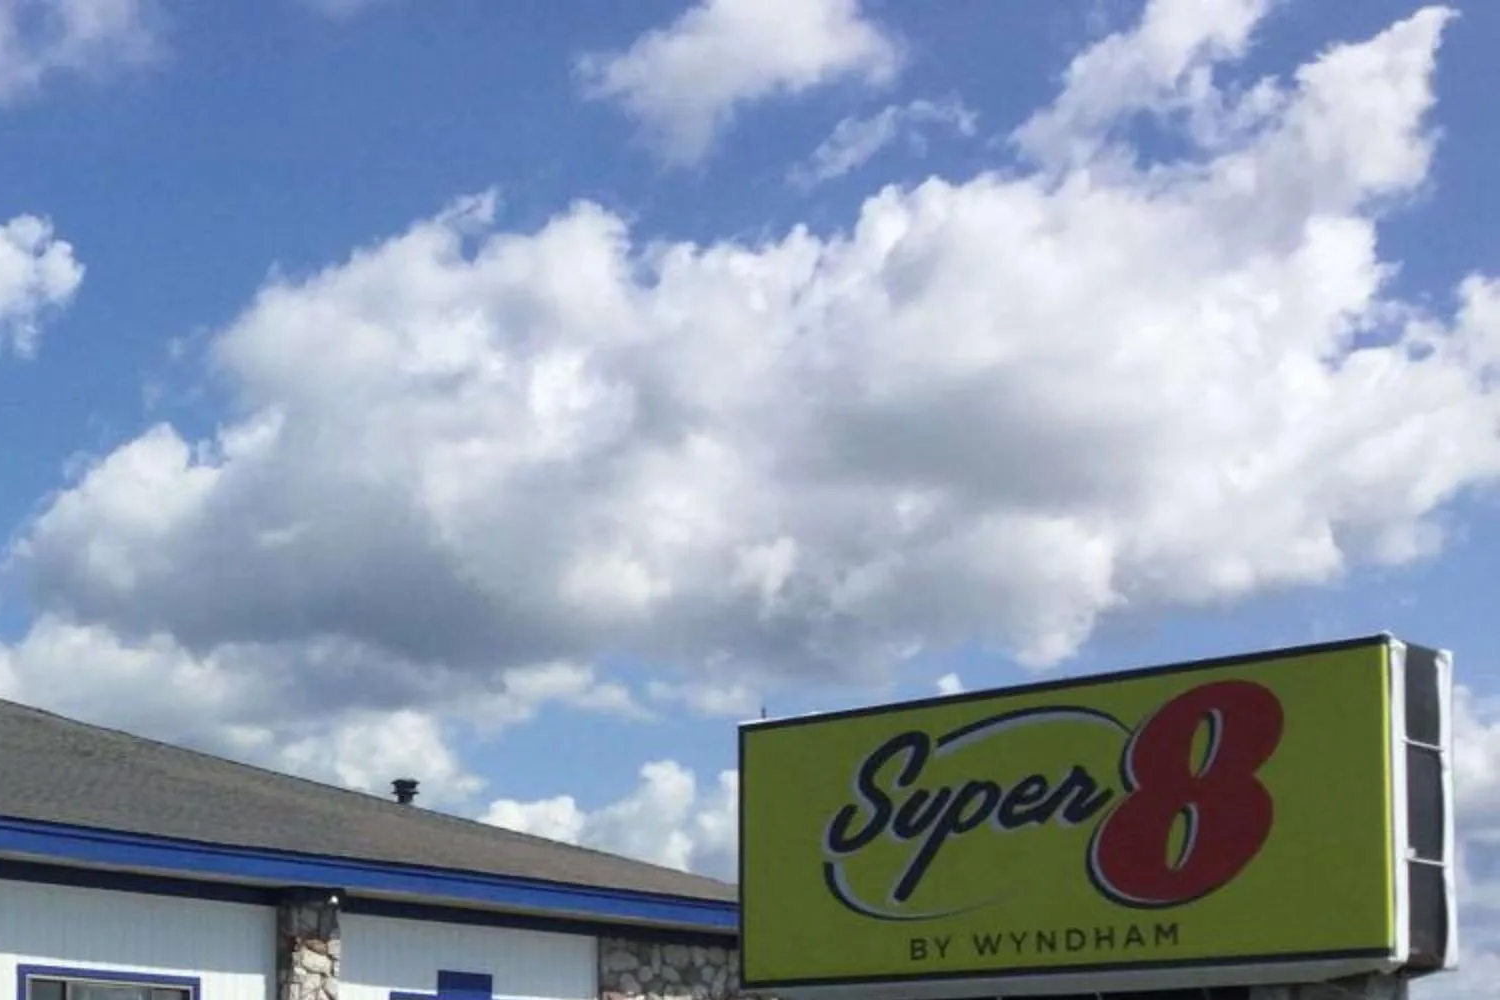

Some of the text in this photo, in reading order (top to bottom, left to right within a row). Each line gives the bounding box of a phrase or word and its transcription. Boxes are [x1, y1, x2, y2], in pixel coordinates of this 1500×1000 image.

[826, 679, 1285, 908] Super 8
[909, 923, 1181, 961] BY WYNDHAM
